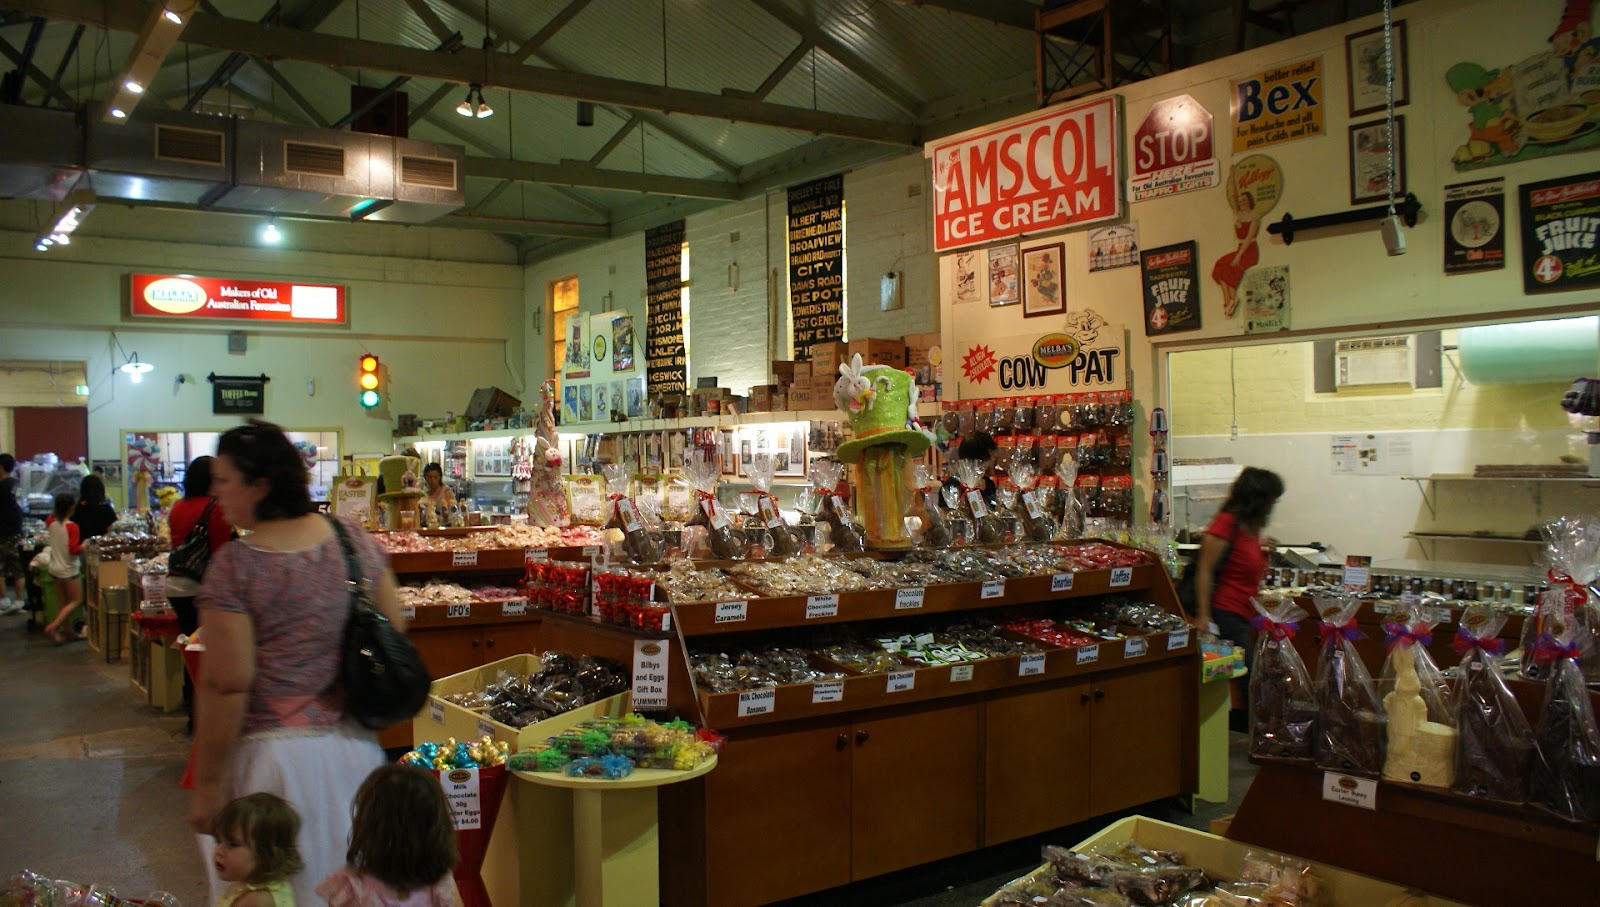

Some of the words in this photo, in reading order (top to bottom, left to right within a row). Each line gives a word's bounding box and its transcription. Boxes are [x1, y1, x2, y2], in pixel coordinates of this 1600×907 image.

[1264, 70, 1290, 83] better
[1292, 61, 1316, 77] relief
[1237, 78, 1318, 122] Bex
[1250, 118, 1285, 133] Headache
[1286, 115, 1300, 127] and
[1302, 112, 1313, 123] all
[1247, 135, 1264, 148] pain
[1266, 130, 1289, 143] Colds
[1291, 127, 1305, 139] and
[1307, 124, 1319, 135] Flu
[1139, 124, 1208, 170] STOP
[943, 113, 1108, 214] AMSCOL
[1143, 182, 1154, 190] Old
[1155, 177, 1183, 188] Australian
[1184, 170, 1214, 181] Favourites
[1135, 184, 1174, 200] TRAFFIC
[791, 212, 819, 228] ALBERT
[820, 207, 841, 221] PARK
[944, 212, 985, 241] ICE
[992, 186, 1101, 231] CREAM
[1535, 216, 1600, 243] FRUIT
[1542, 233, 1596, 256] JUICE
[798, 261, 834, 277] CITY
[791, 279, 816, 292] DAWS
[817, 275, 841, 288] ROAD
[1151, 278, 1191, 297] FRUIT
[220, 285, 251, 298] Makers
[251, 287, 261, 298] of
[261, 287, 278, 299] Old
[792, 288, 842, 305] DEPOT
[1155, 290, 1187, 307] JUICE
[207, 298, 249, 310] Australian
[793, 327, 842, 342] ENFELD
[1040, 344, 1073, 354] MELBA'S
[1000, 357, 1046, 389] COW
[1071, 350, 1119, 384] PAT
[649, 371, 683, 382] KESWICK
[1053, 575, 1073, 588] Smarties
[1112, 570, 1130, 583] Jaffas
[898, 589, 924, 598] Chocolate
[448, 604, 470, 617] UFO's
[721, 603, 743, 611] Jersey
[716, 613, 746, 622] Caramels
[641, 661, 660, 670] Bilbys
[1078, 655, 1098, 664] Jaffas
[649, 674, 665, 683] Eggs
[637, 685, 649, 693] Gift
[740, 692, 752, 702] Milk
[752, 690, 775, 701] Chocolate
[747, 705, 767, 714] Bananas
